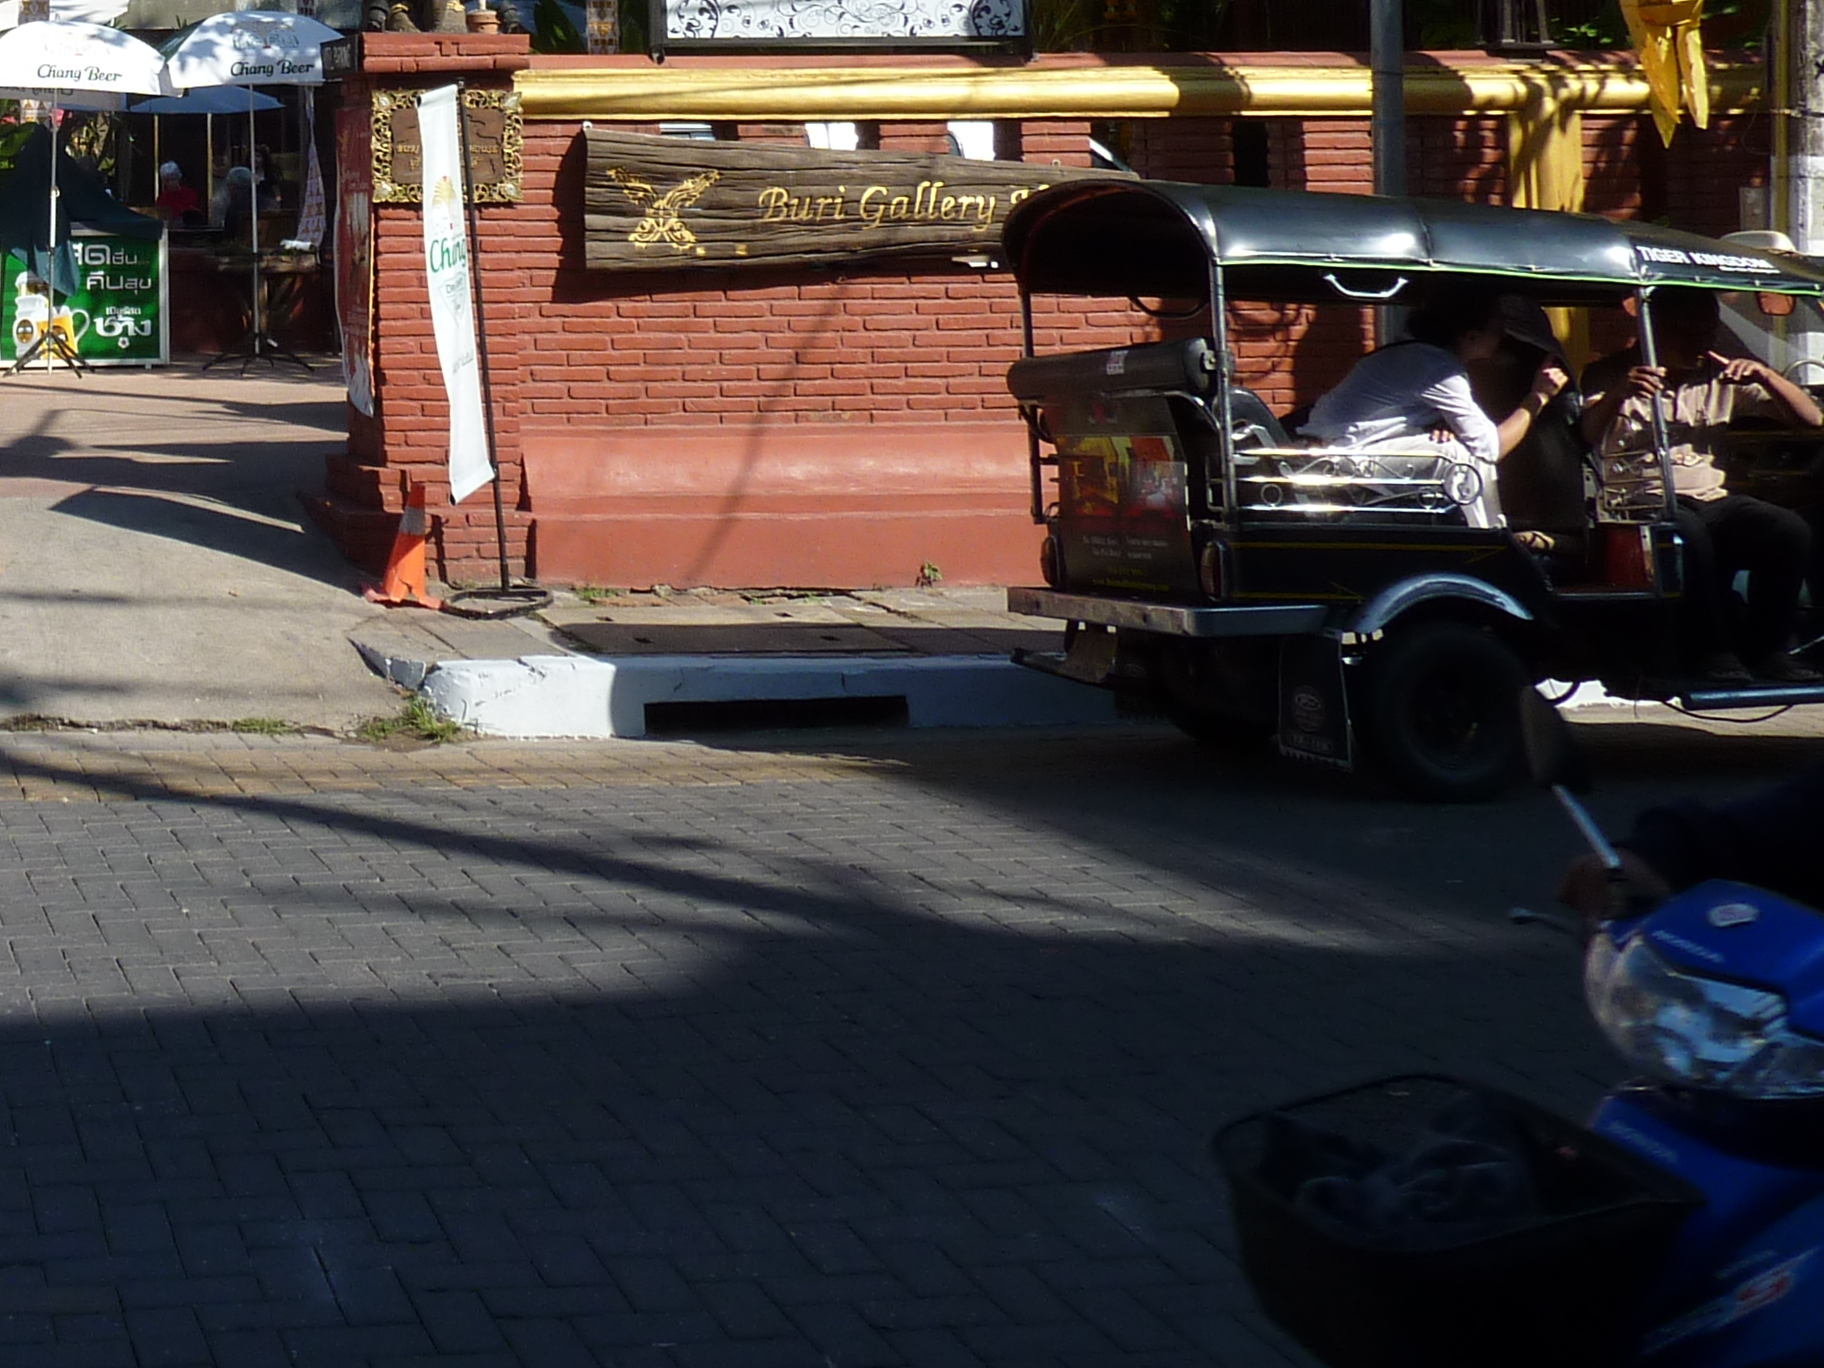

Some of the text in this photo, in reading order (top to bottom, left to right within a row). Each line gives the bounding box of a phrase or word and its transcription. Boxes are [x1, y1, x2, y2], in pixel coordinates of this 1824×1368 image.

[37, 64, 123, 83] Chang Beer
[230, 59, 316, 77] Chang Beer
[758, 184, 847, 223] Buri
[860, 181, 997, 232] Gallery
[430, 237, 467, 273] Chang
[1636, 245, 1774, 269] TIGER KINGDOM
